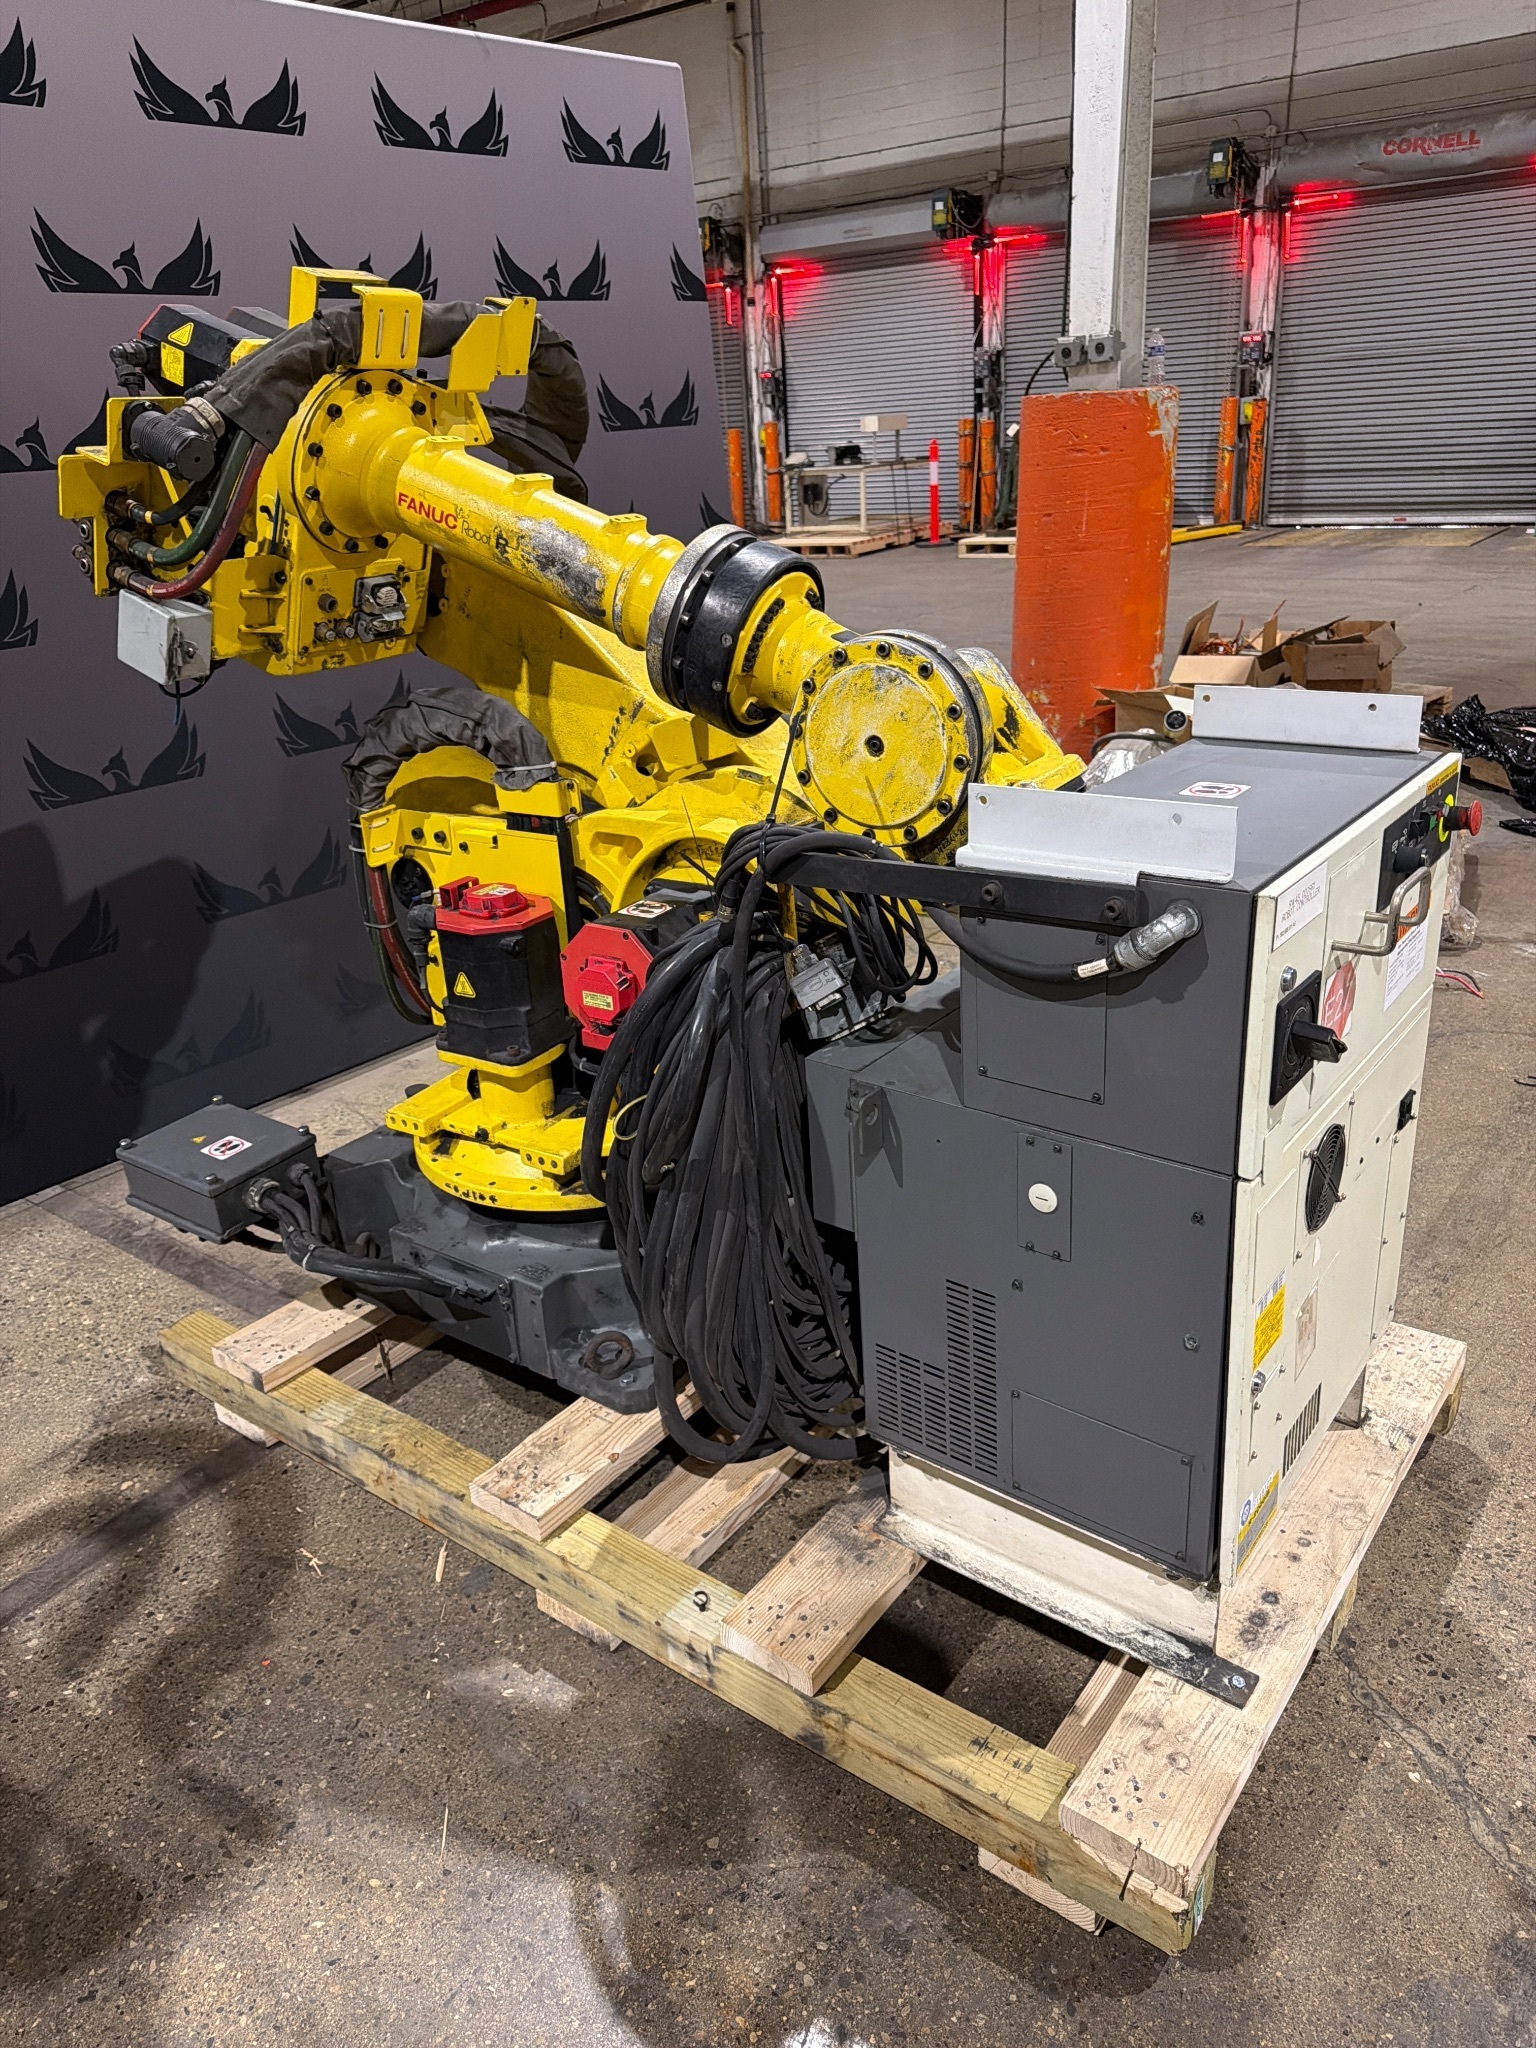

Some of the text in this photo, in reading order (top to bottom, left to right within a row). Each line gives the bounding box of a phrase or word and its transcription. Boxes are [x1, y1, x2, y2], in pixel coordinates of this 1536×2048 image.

[1383, 129, 1481, 156] CORNELL
[398, 492, 458, 530] FANUC
[461, 519, 492, 546] Robot
